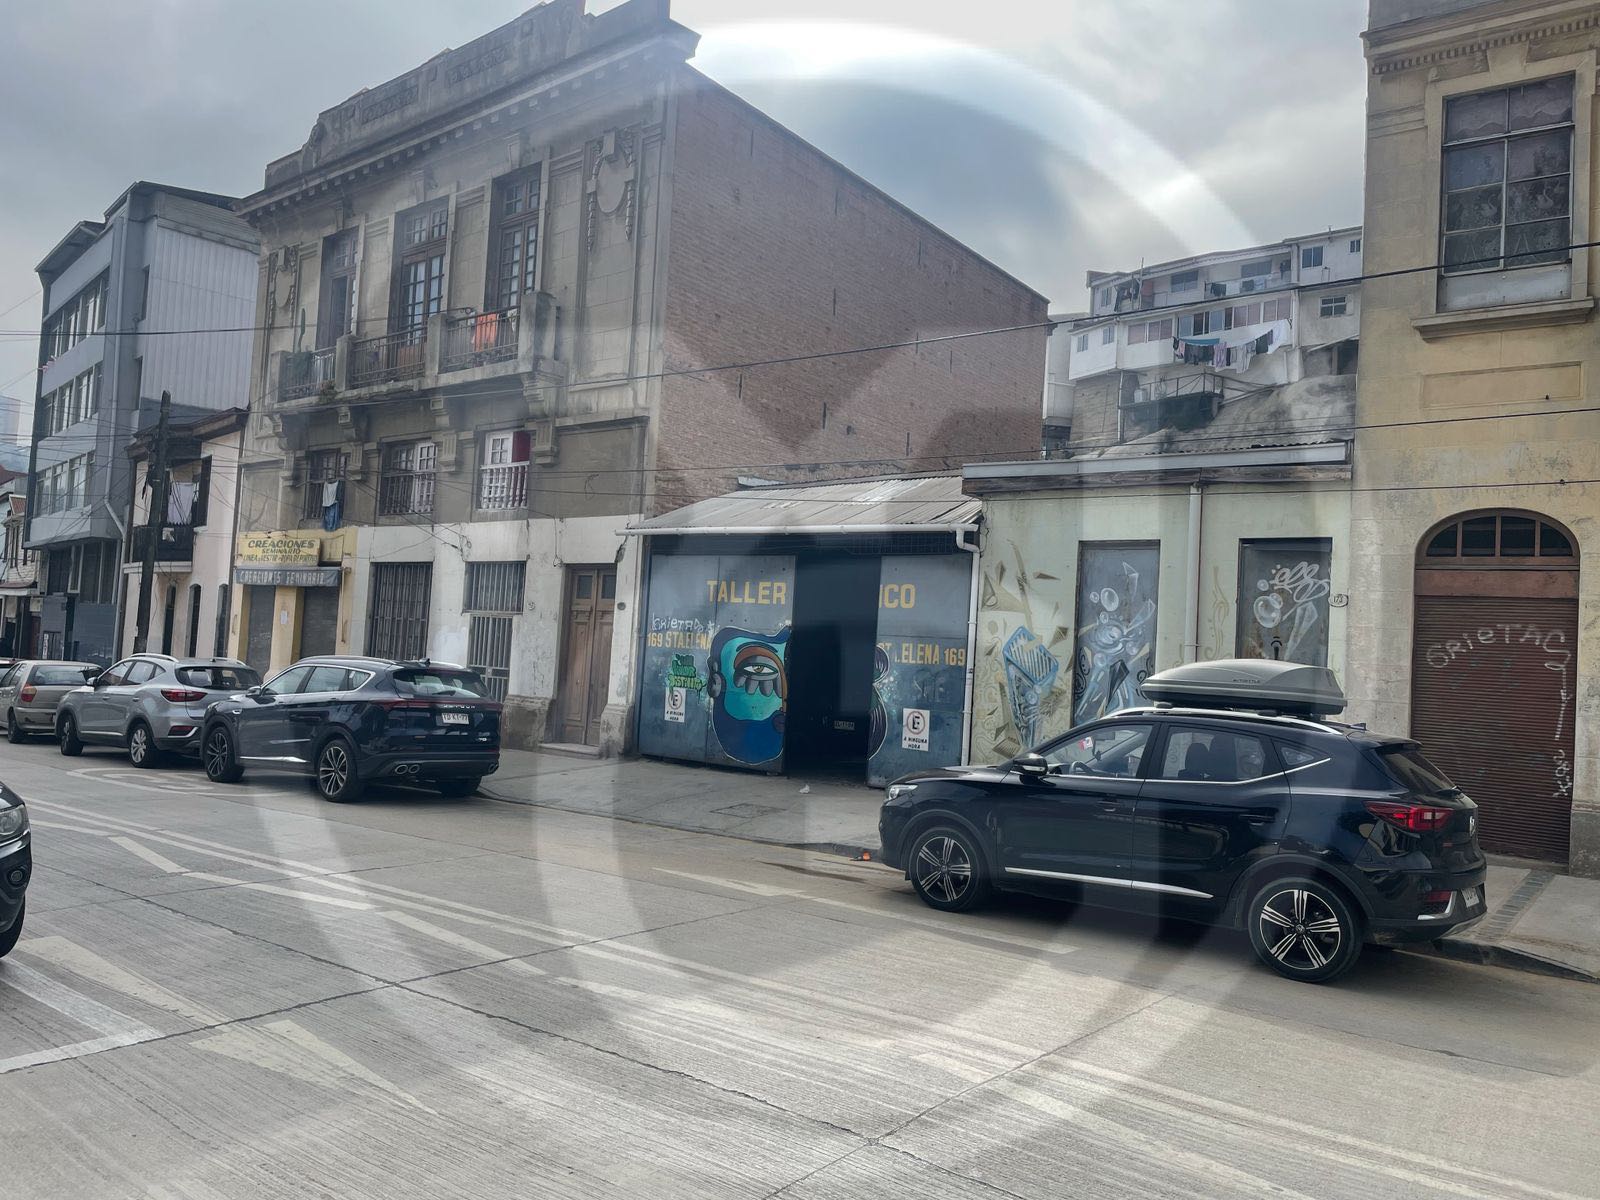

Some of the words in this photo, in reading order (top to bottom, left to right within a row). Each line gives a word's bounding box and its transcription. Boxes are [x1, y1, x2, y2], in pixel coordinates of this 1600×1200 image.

[248, 540, 315, 548] CREACIONES
[240, 571, 281, 583] CREACIONES
[286, 571, 324, 585] SEMINARIO
[707, 580, 787, 604] TALLER
[647, 632, 662, 647] 169
[902, 642, 940, 665] ELENA
[944, 648, 965, 666] 169
